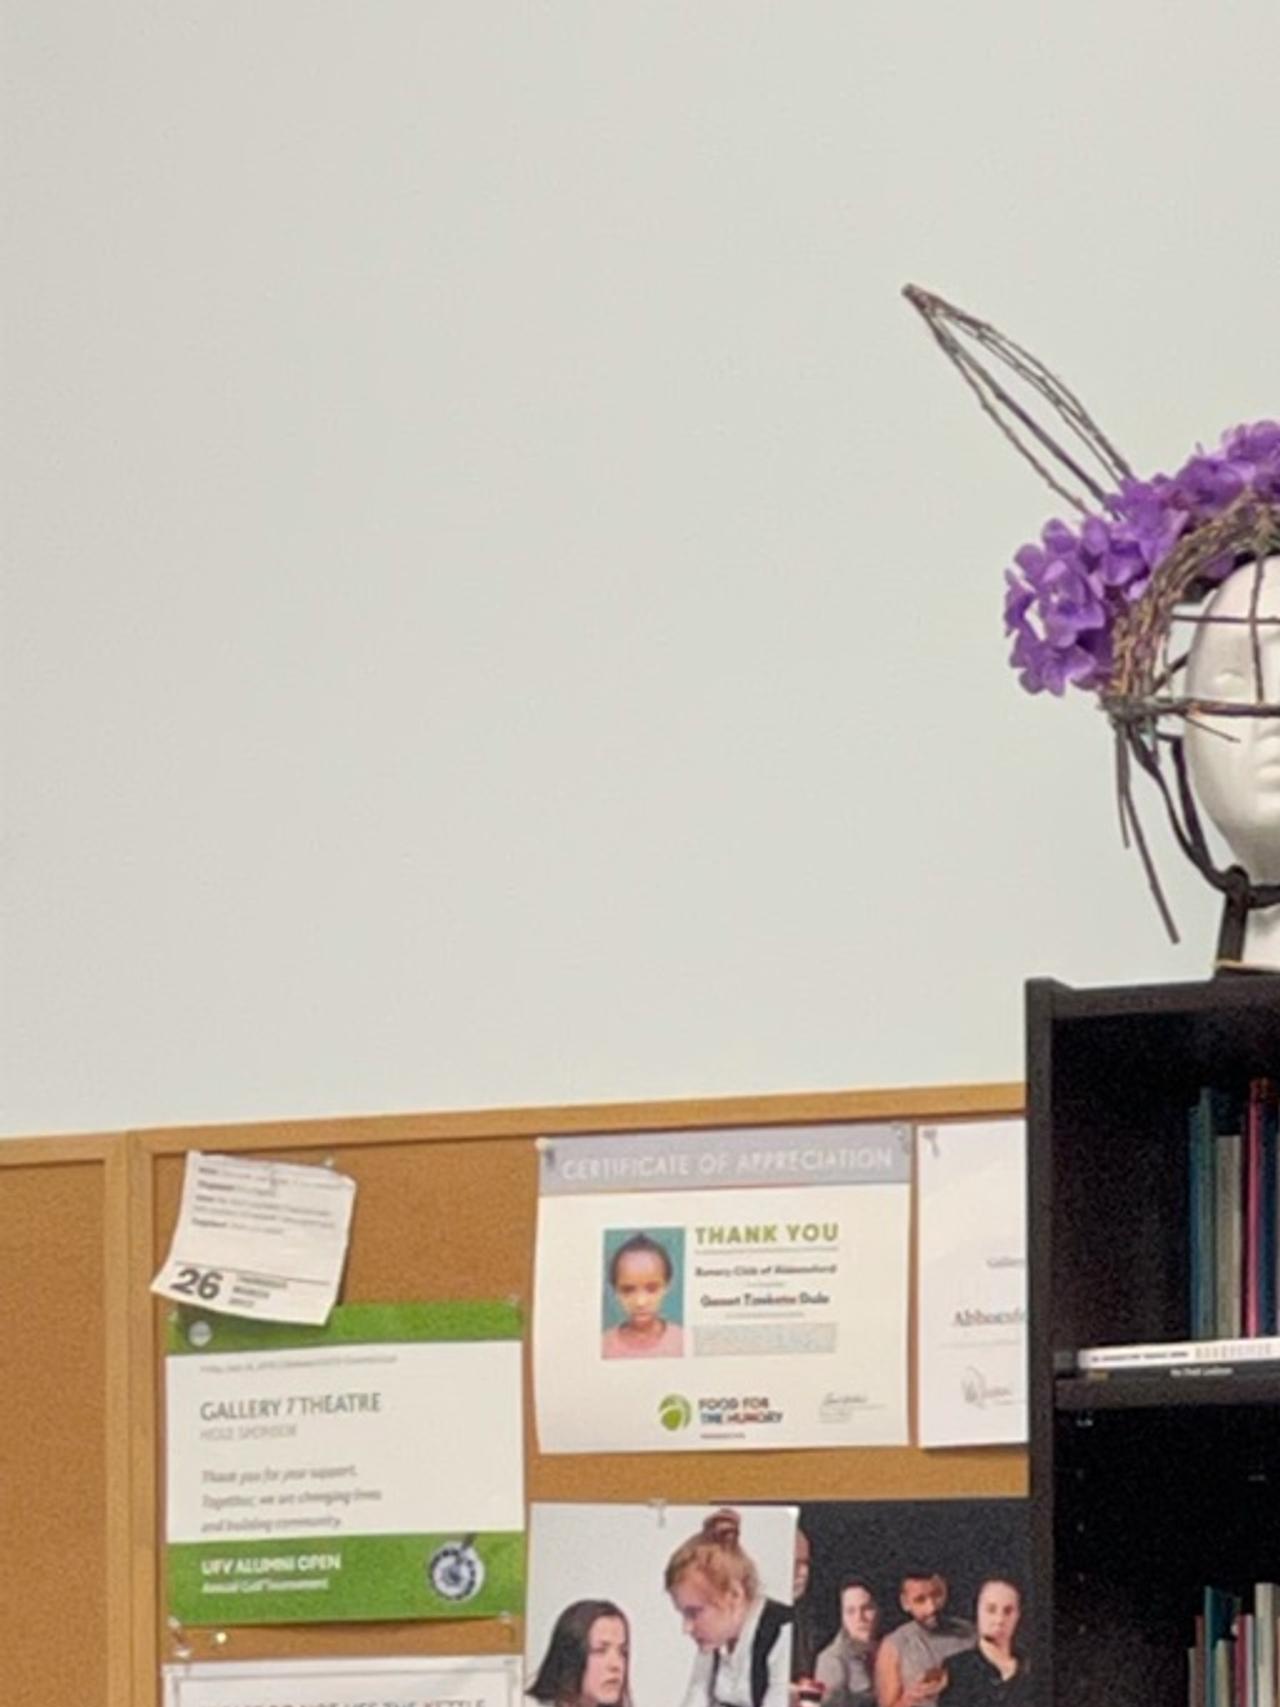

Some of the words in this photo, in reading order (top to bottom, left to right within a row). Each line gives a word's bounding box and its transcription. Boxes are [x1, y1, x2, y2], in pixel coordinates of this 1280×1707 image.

[562, 1156, 689, 1182] CERTIFICATE
[701, 1152, 729, 1175] OF
[737, 1145, 894, 1174] APPRECIATION
[695, 1225, 778, 1245] THANK
[786, 1222, 840, 1242] YOU
[169, 1267, 224, 1300] 26
[200, 1399, 281, 1421] GALLERY
[297, 1392, 382, 1416] THEATRE
[698, 1397, 739, 1410] FOOD
[742, 1396, 769, 1409] FOR
